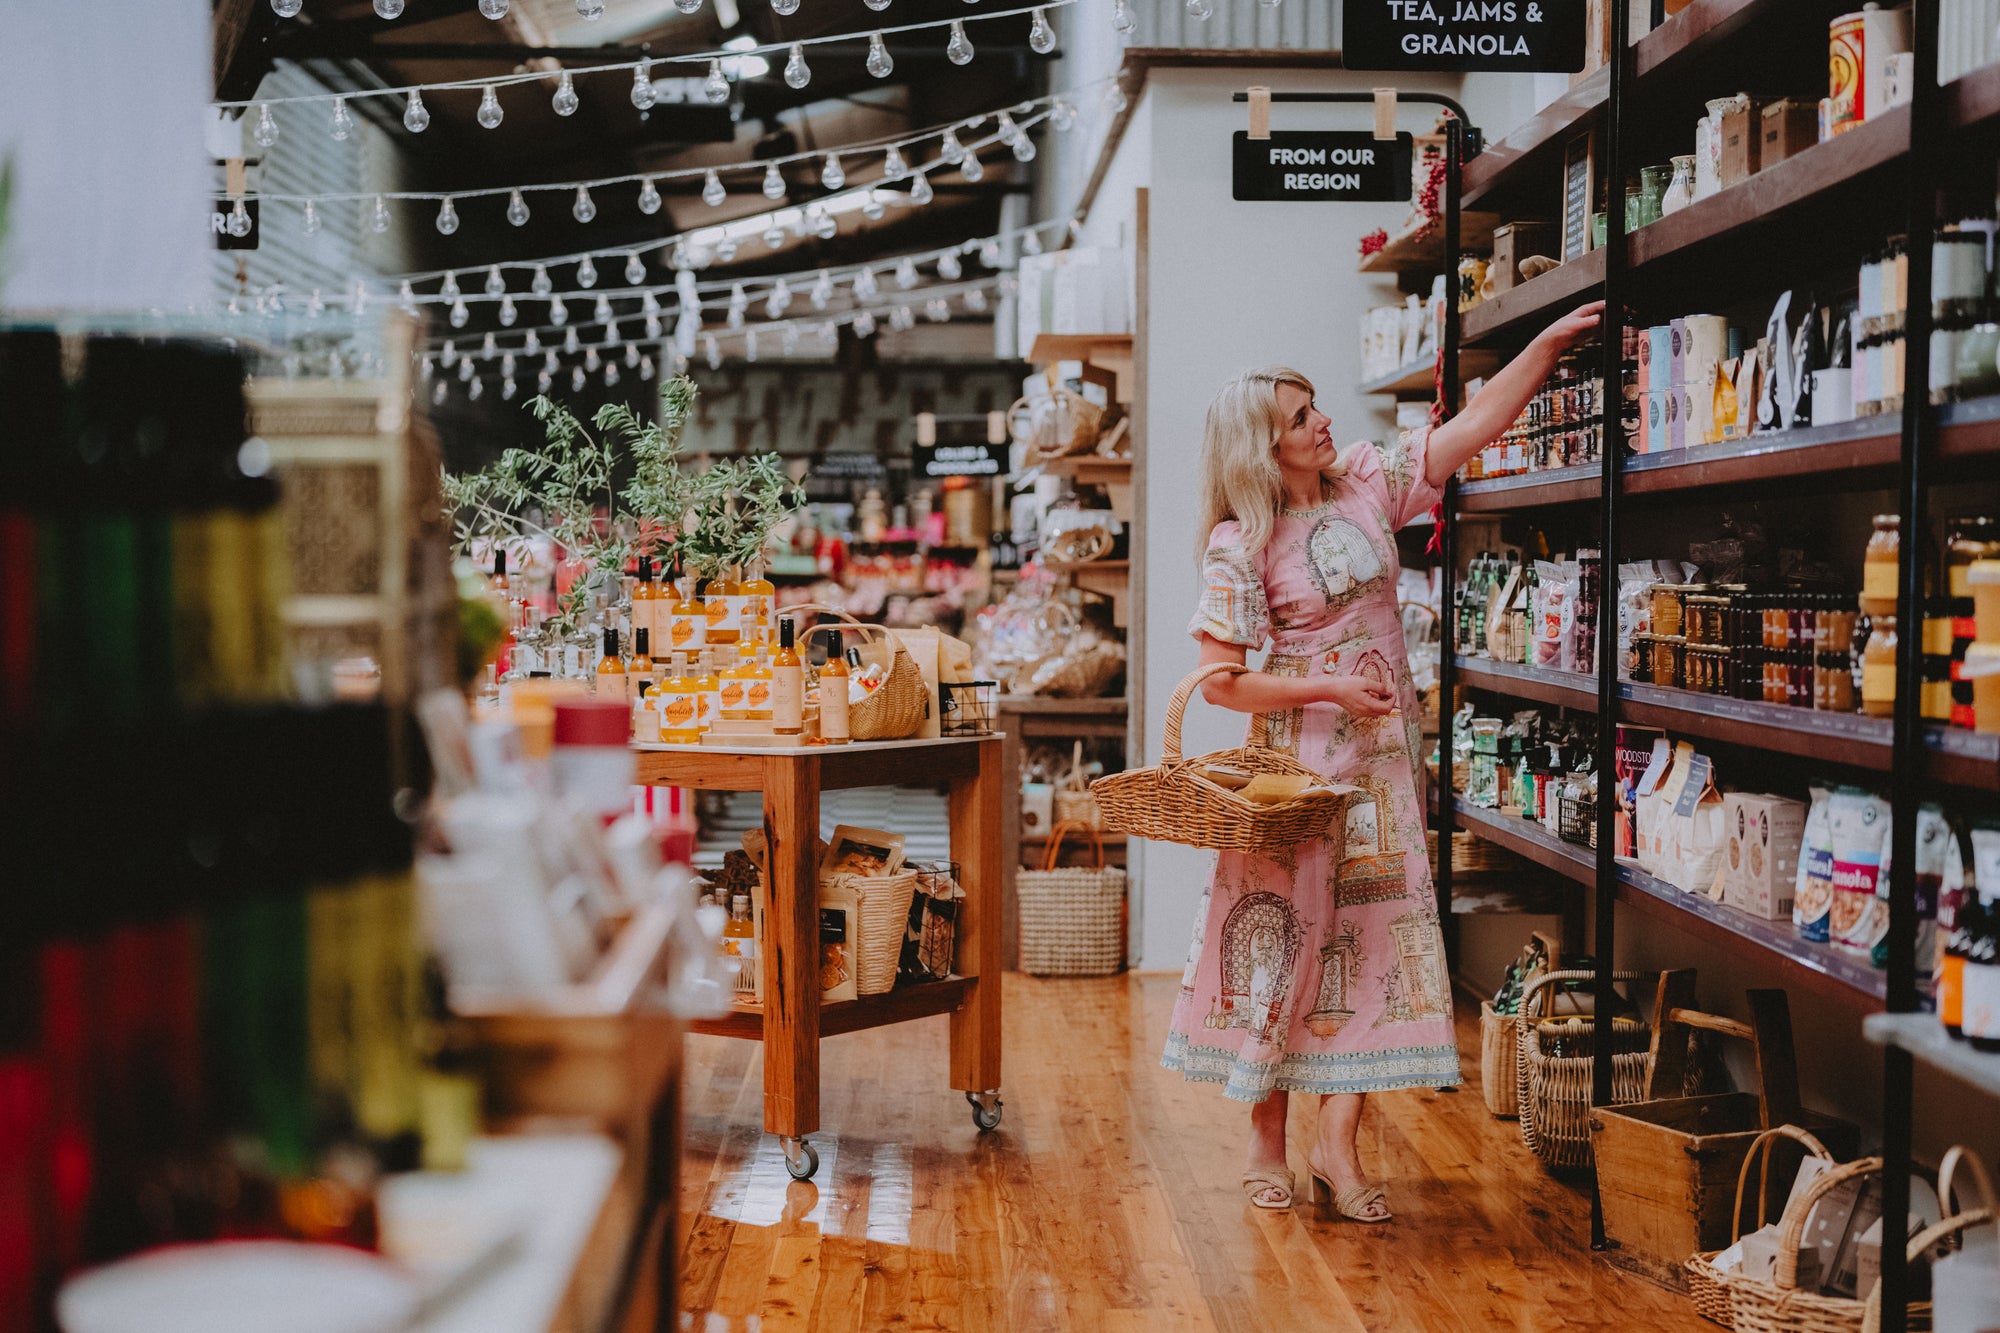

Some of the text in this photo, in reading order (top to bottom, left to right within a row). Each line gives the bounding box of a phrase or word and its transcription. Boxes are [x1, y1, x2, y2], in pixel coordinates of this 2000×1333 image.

[1387, 1, 1542, 25] TEA, JAMS &
[1402, 34, 1530, 55] GRANOLA
[1270, 149, 1374, 165] FROM OUR
[1285, 174, 1359, 189] REGION
[1616, 749, 1651, 764] WOODSTO
